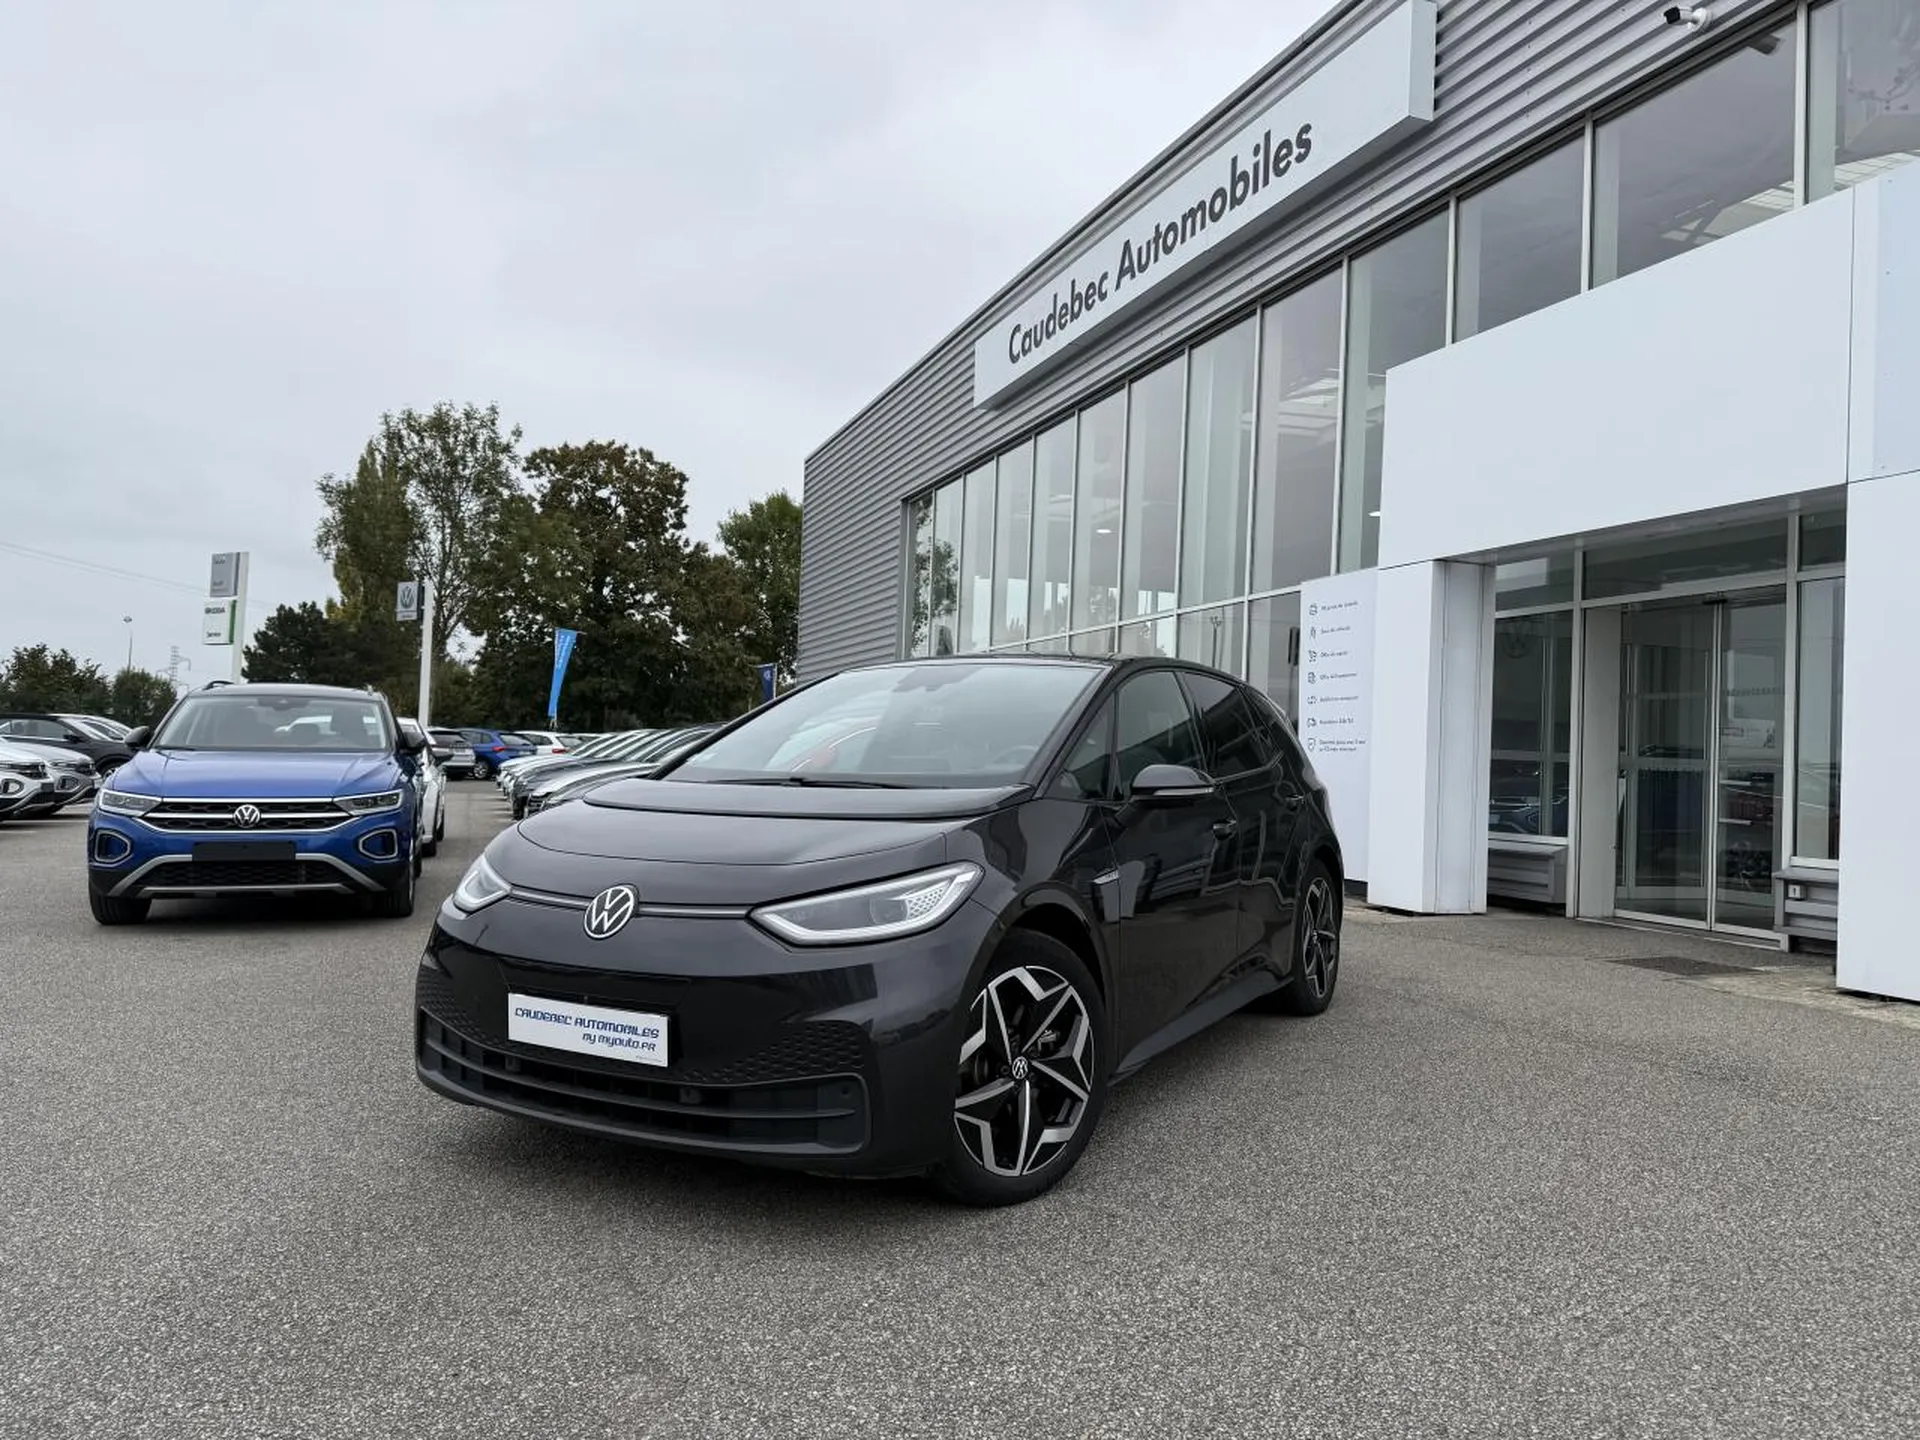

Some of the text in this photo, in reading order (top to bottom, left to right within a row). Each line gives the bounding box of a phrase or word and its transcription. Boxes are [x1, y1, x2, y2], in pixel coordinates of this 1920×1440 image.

[1008, 122, 1313, 364] Caudebec Automobiles
[514, 1007, 572, 1025] CAUDEBEC
